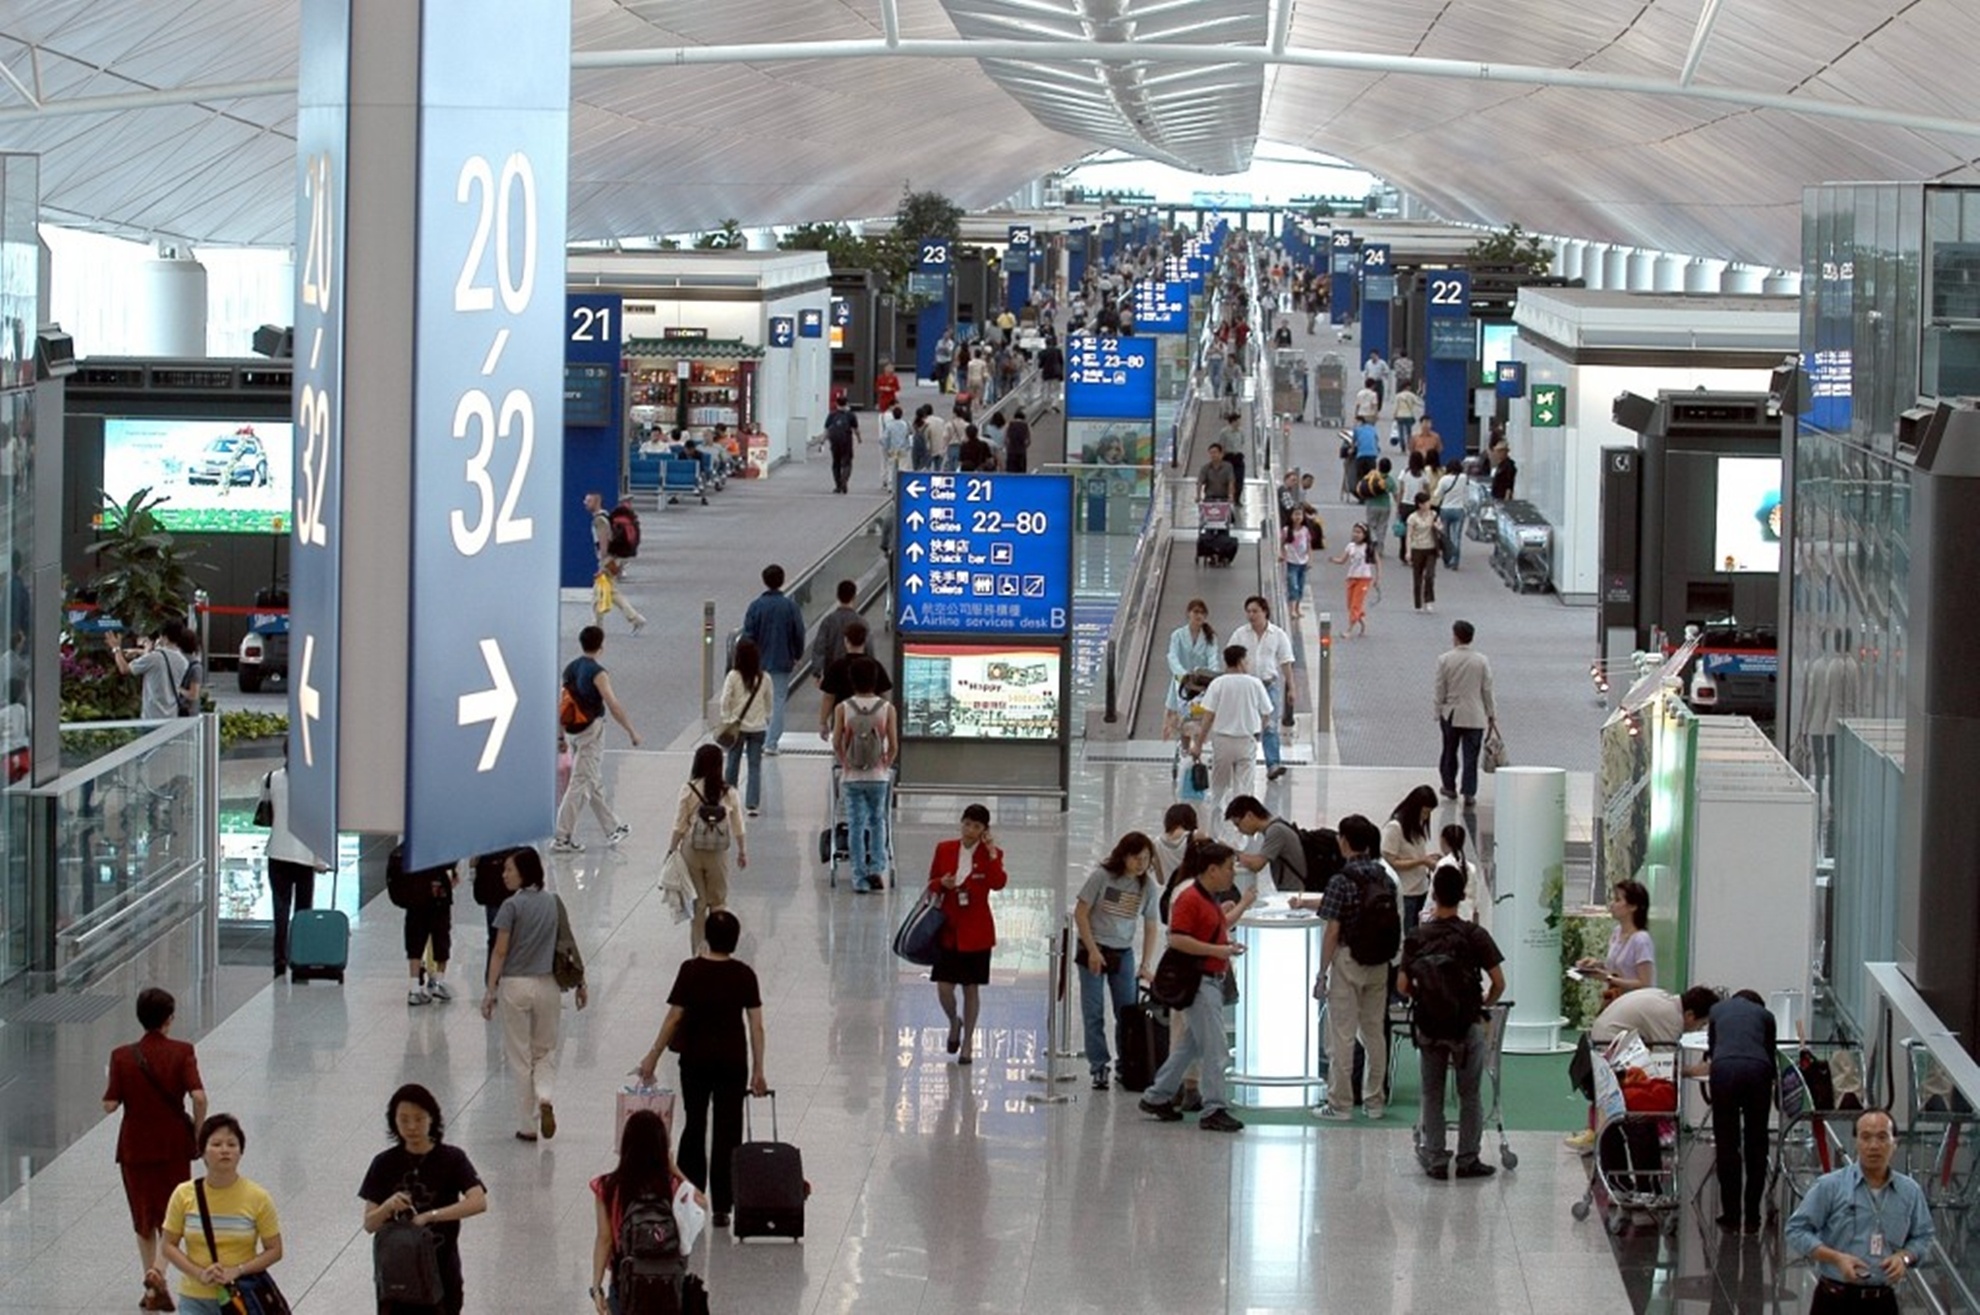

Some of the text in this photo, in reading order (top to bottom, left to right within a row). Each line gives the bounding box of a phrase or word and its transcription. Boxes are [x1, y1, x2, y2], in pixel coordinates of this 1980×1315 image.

[303, 153, 332, 315] 20
[454, 152, 538, 315] 20
[1012, 230, 1029, 243] 25
[923, 246, 946, 263] 23
[1365, 250, 1385, 265] 24
[1432, 281, 1463, 304] 22
[571, 306, 611, 342] 21
[1101, 338, 1119, 352] 22
[297, 384, 330, 548] 32
[450, 387, 535, 557] 32
[966, 479, 992, 502] 21
[899, 604, 919, 626] A
[921, 615, 1048, 630] Airline services desk
[1050, 607, 1067, 629] B
